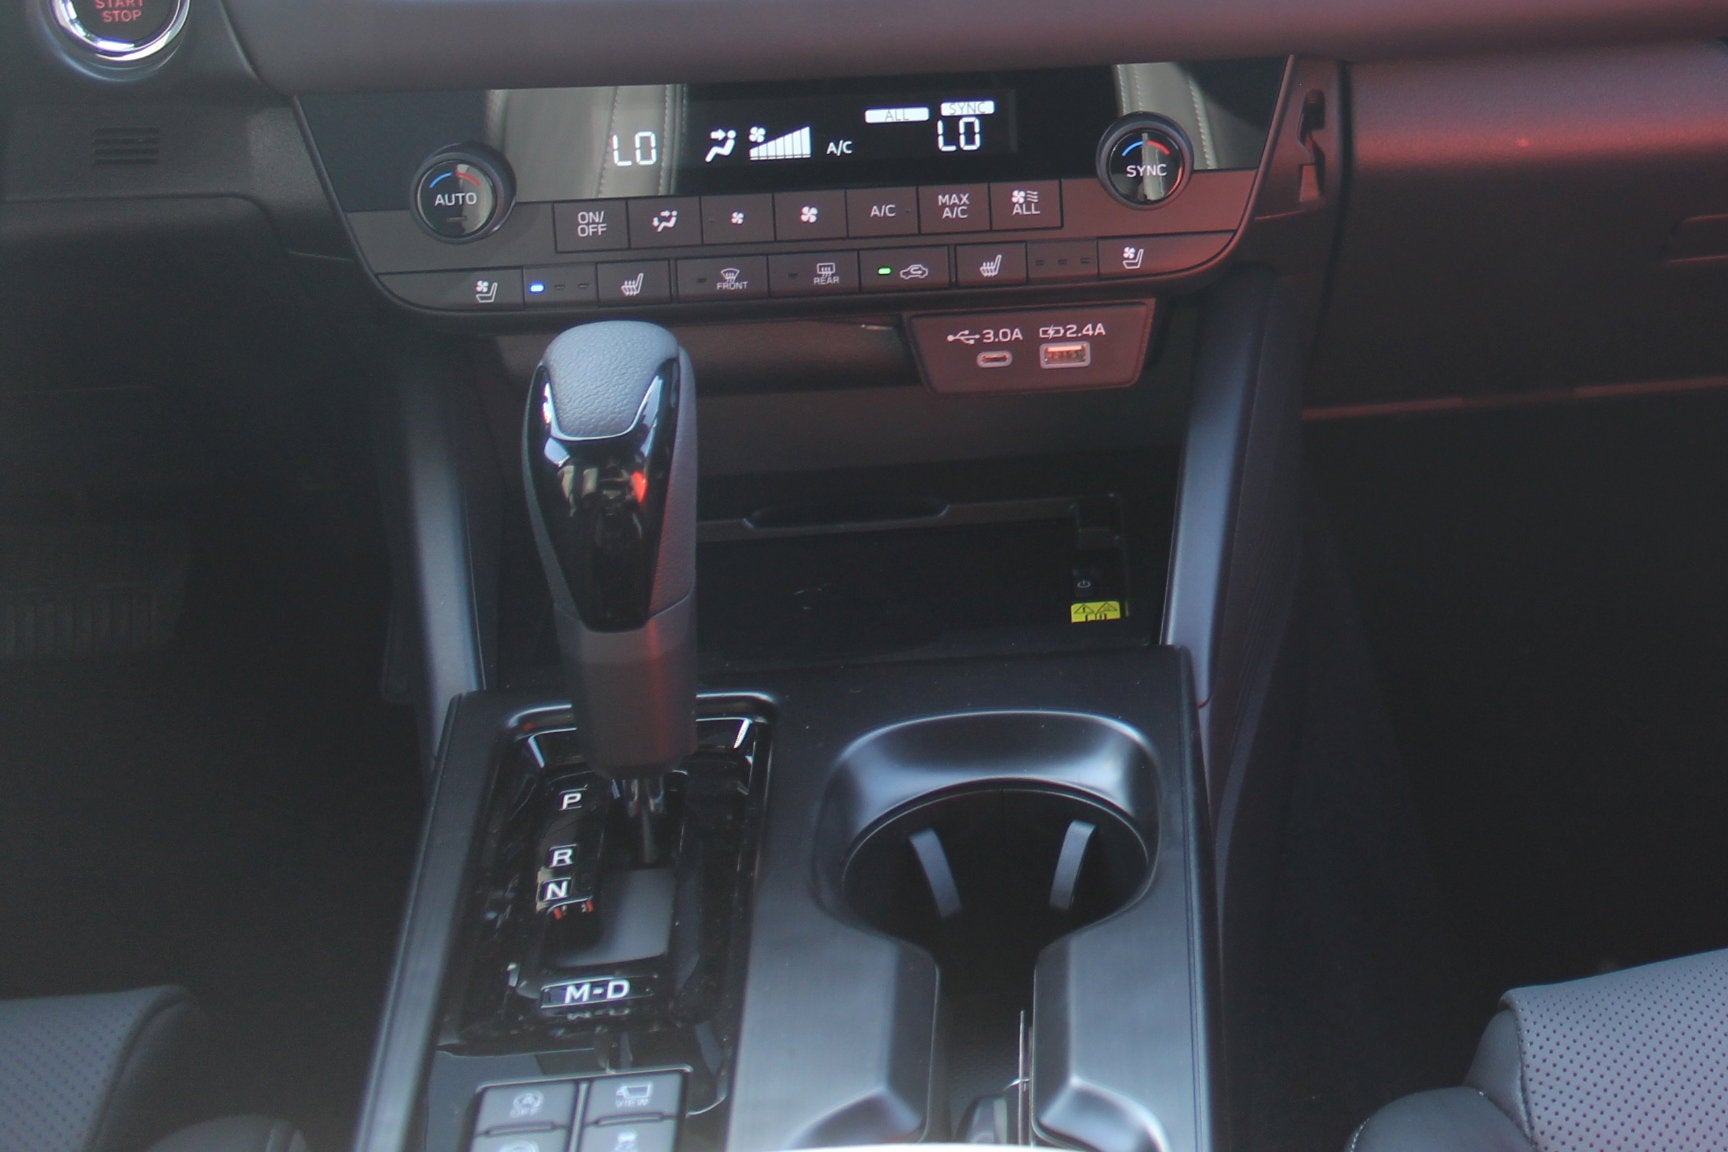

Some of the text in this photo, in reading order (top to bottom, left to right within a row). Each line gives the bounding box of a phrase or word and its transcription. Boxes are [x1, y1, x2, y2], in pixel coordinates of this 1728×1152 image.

[102, 9, 142, 23] STOP
[948, 101, 987, 115] SYNC
[884, 110, 910, 122] ALL
[937, 116, 981, 152] LO
[612, 131, 657, 167] LO
[826, 140, 853, 157] A/C
[1125, 164, 1168, 178] SYNC
[434, 192, 478, 207] AUTO
[938, 193, 971, 206] MAX
[870, 204, 896, 218] A/C
[941, 206, 968, 220] A/C
[1012, 203, 1041, 216] ALL
[577, 210, 605, 224] ON/
[577, 224, 608, 238] OFF
[716, 280, 749, 291] FRONT
[813, 275, 840, 286] REAR
[982, 328, 1024, 343] 3.0A
[1065, 323, 1106, 338] 2.4A
[561, 792, 583, 810] P
[551, 849, 573, 867] R
[544, 881, 569, 900] N
[563, 979, 631, 1004] M-D
